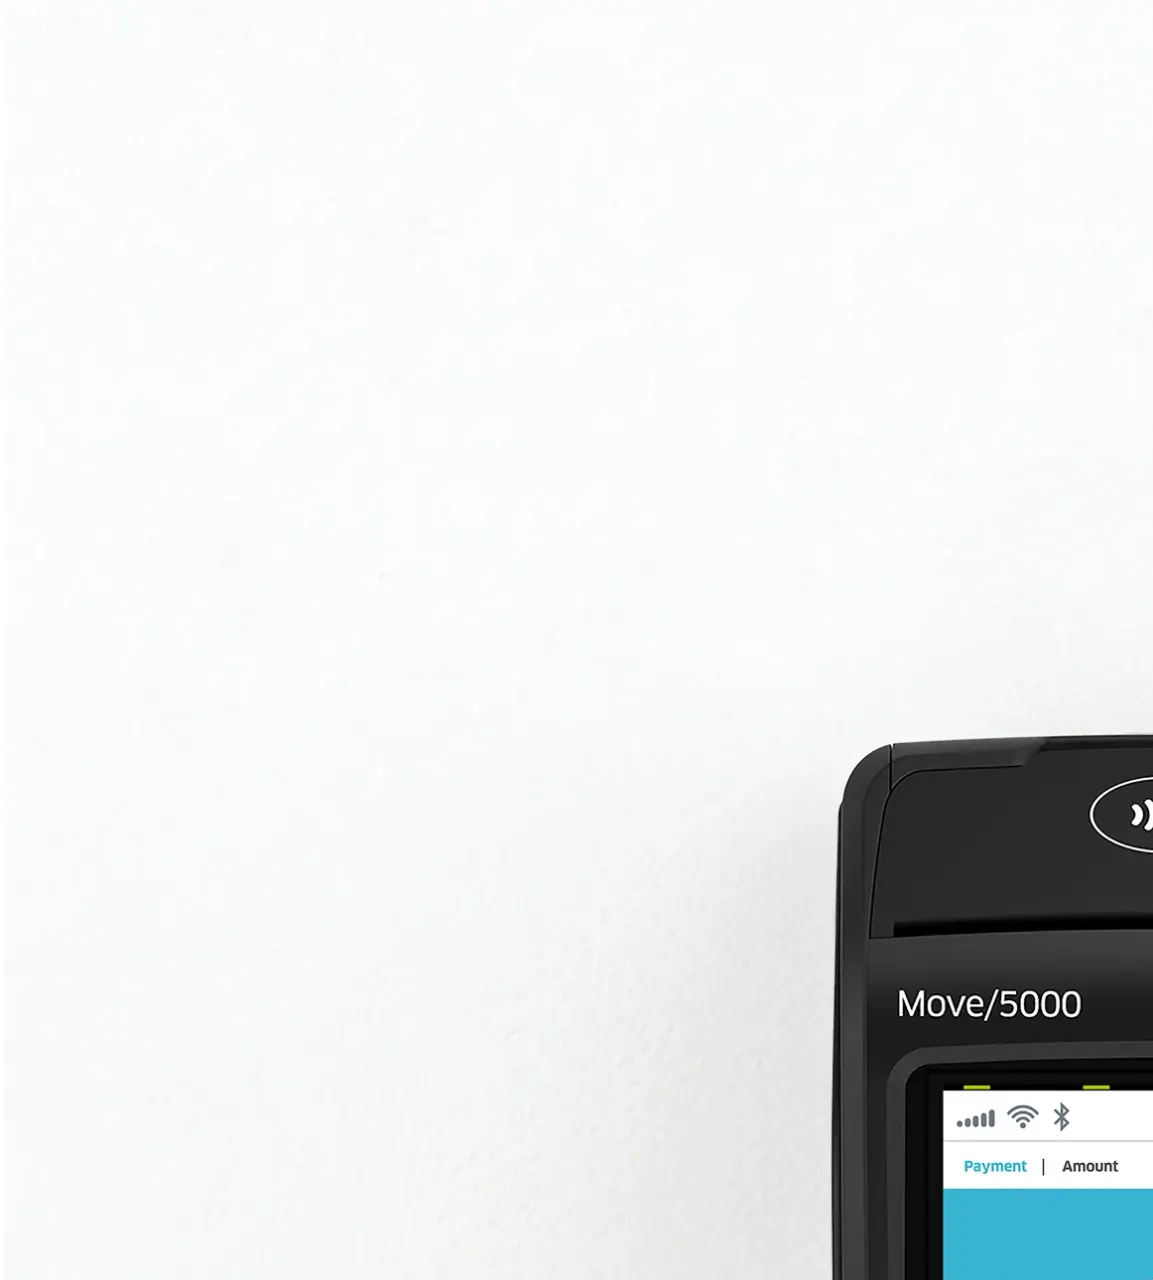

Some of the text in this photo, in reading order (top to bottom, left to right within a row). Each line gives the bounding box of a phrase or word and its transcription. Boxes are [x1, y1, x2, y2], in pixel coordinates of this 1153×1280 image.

[899, 989, 1081, 1021] Move/5000
[965, 1161, 1027, 1174] Payment
[1062, 1161, 1118, 1172] Amount
